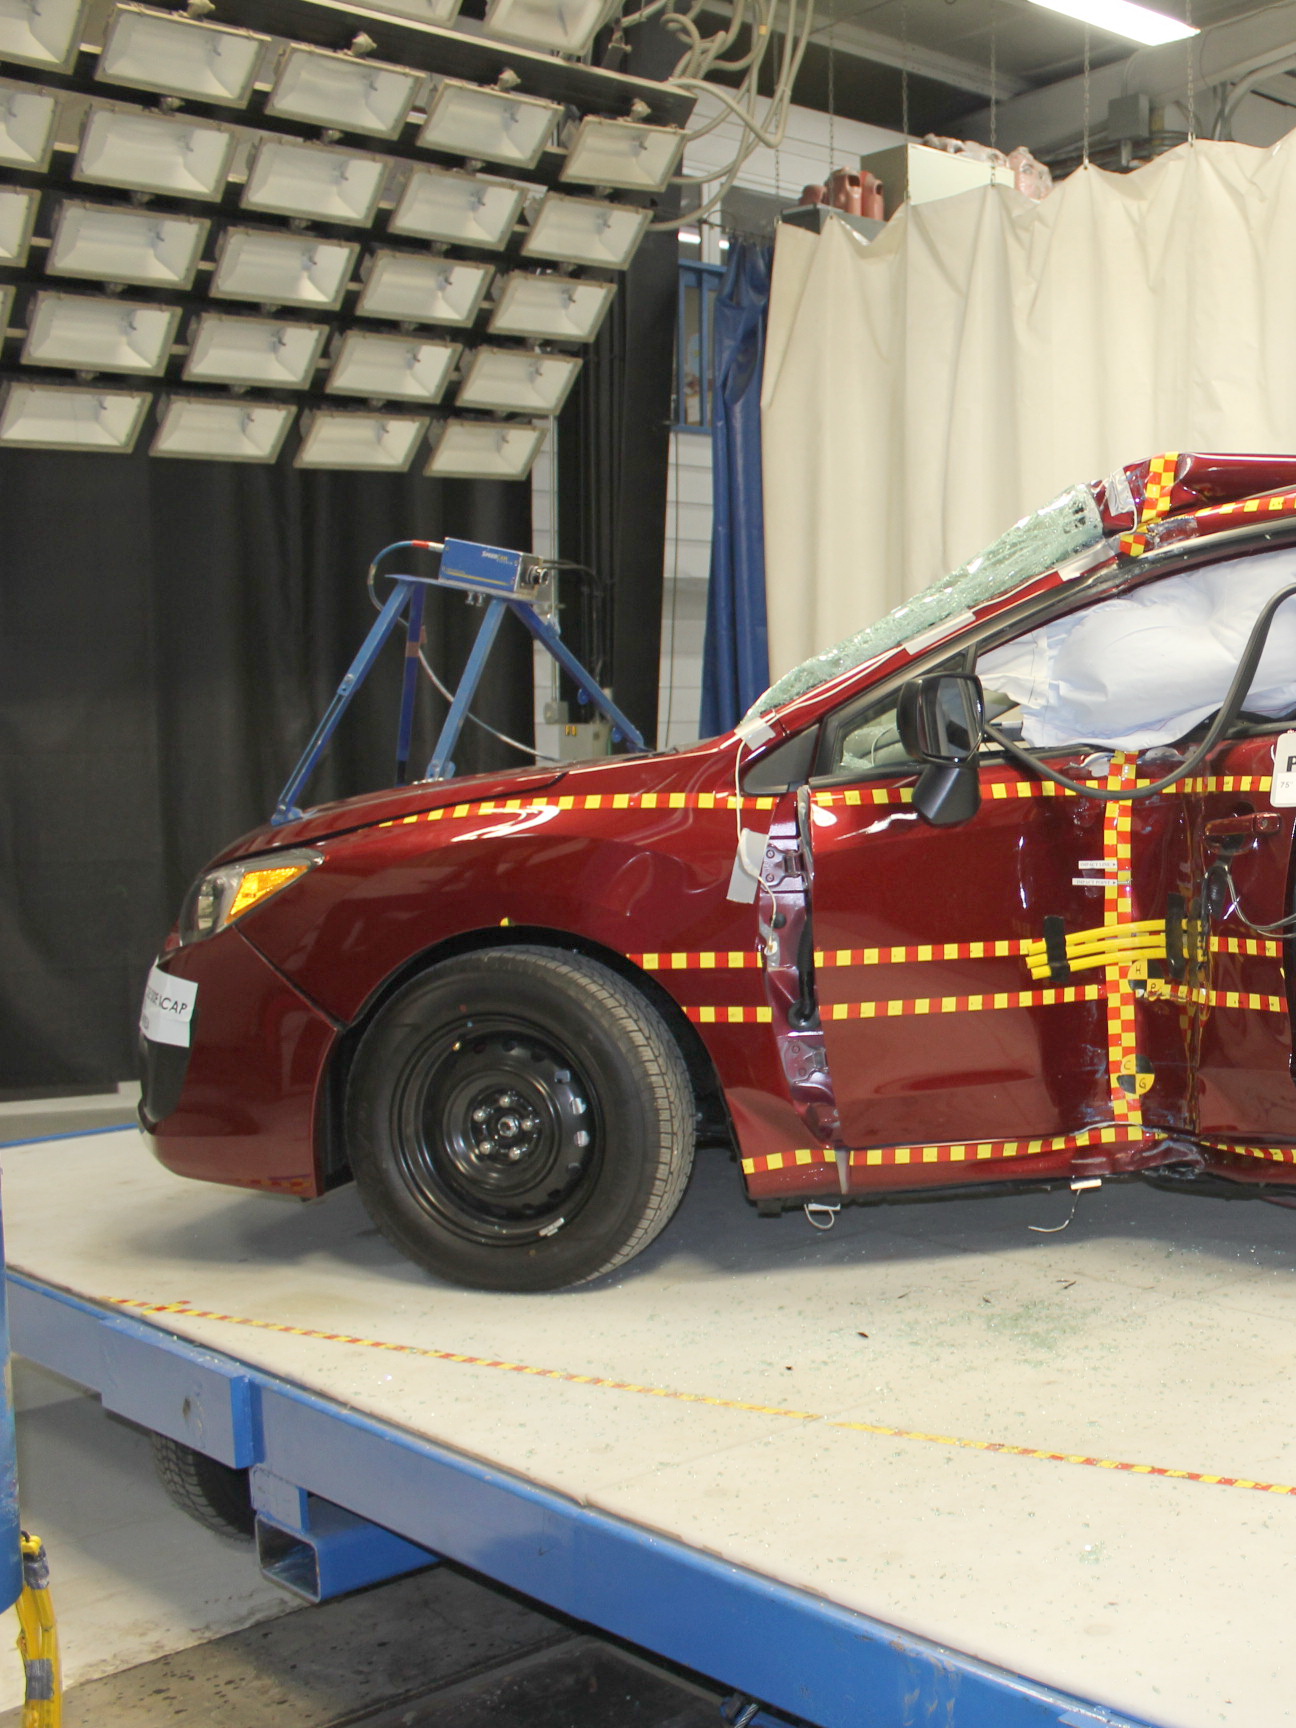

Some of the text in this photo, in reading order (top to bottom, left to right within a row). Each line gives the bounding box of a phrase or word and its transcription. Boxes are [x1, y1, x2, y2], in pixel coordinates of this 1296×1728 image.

[1135, 965, 1142, 976] H
[1123, 1059, 1132, 1070] C
[1138, 1077, 1147, 1090] G
